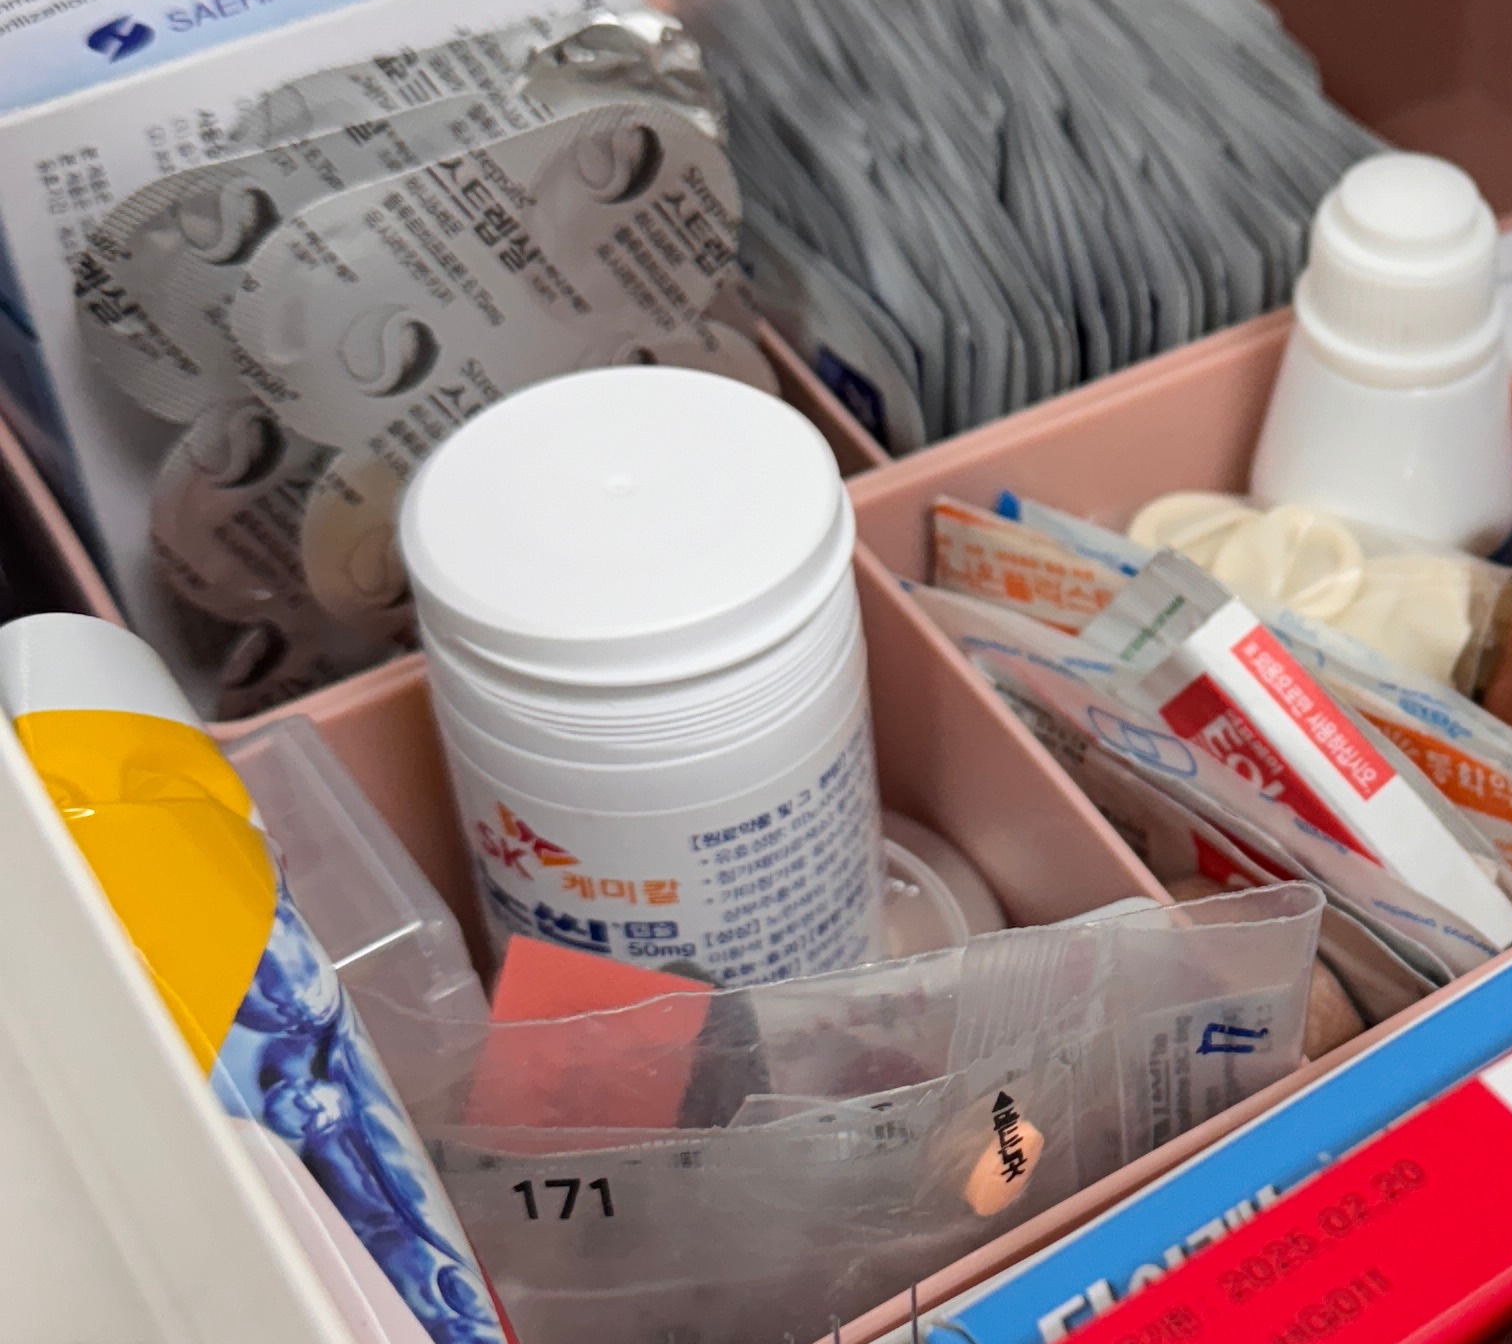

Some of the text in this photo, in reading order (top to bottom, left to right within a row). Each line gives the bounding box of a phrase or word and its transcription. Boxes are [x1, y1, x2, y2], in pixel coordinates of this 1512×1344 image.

[425, 148, 542, 275] 스트렙실
[472, 820, 538, 880] SK
[559, 869, 681, 908] 케미칼
[511, 1178, 614, 1222] 171
